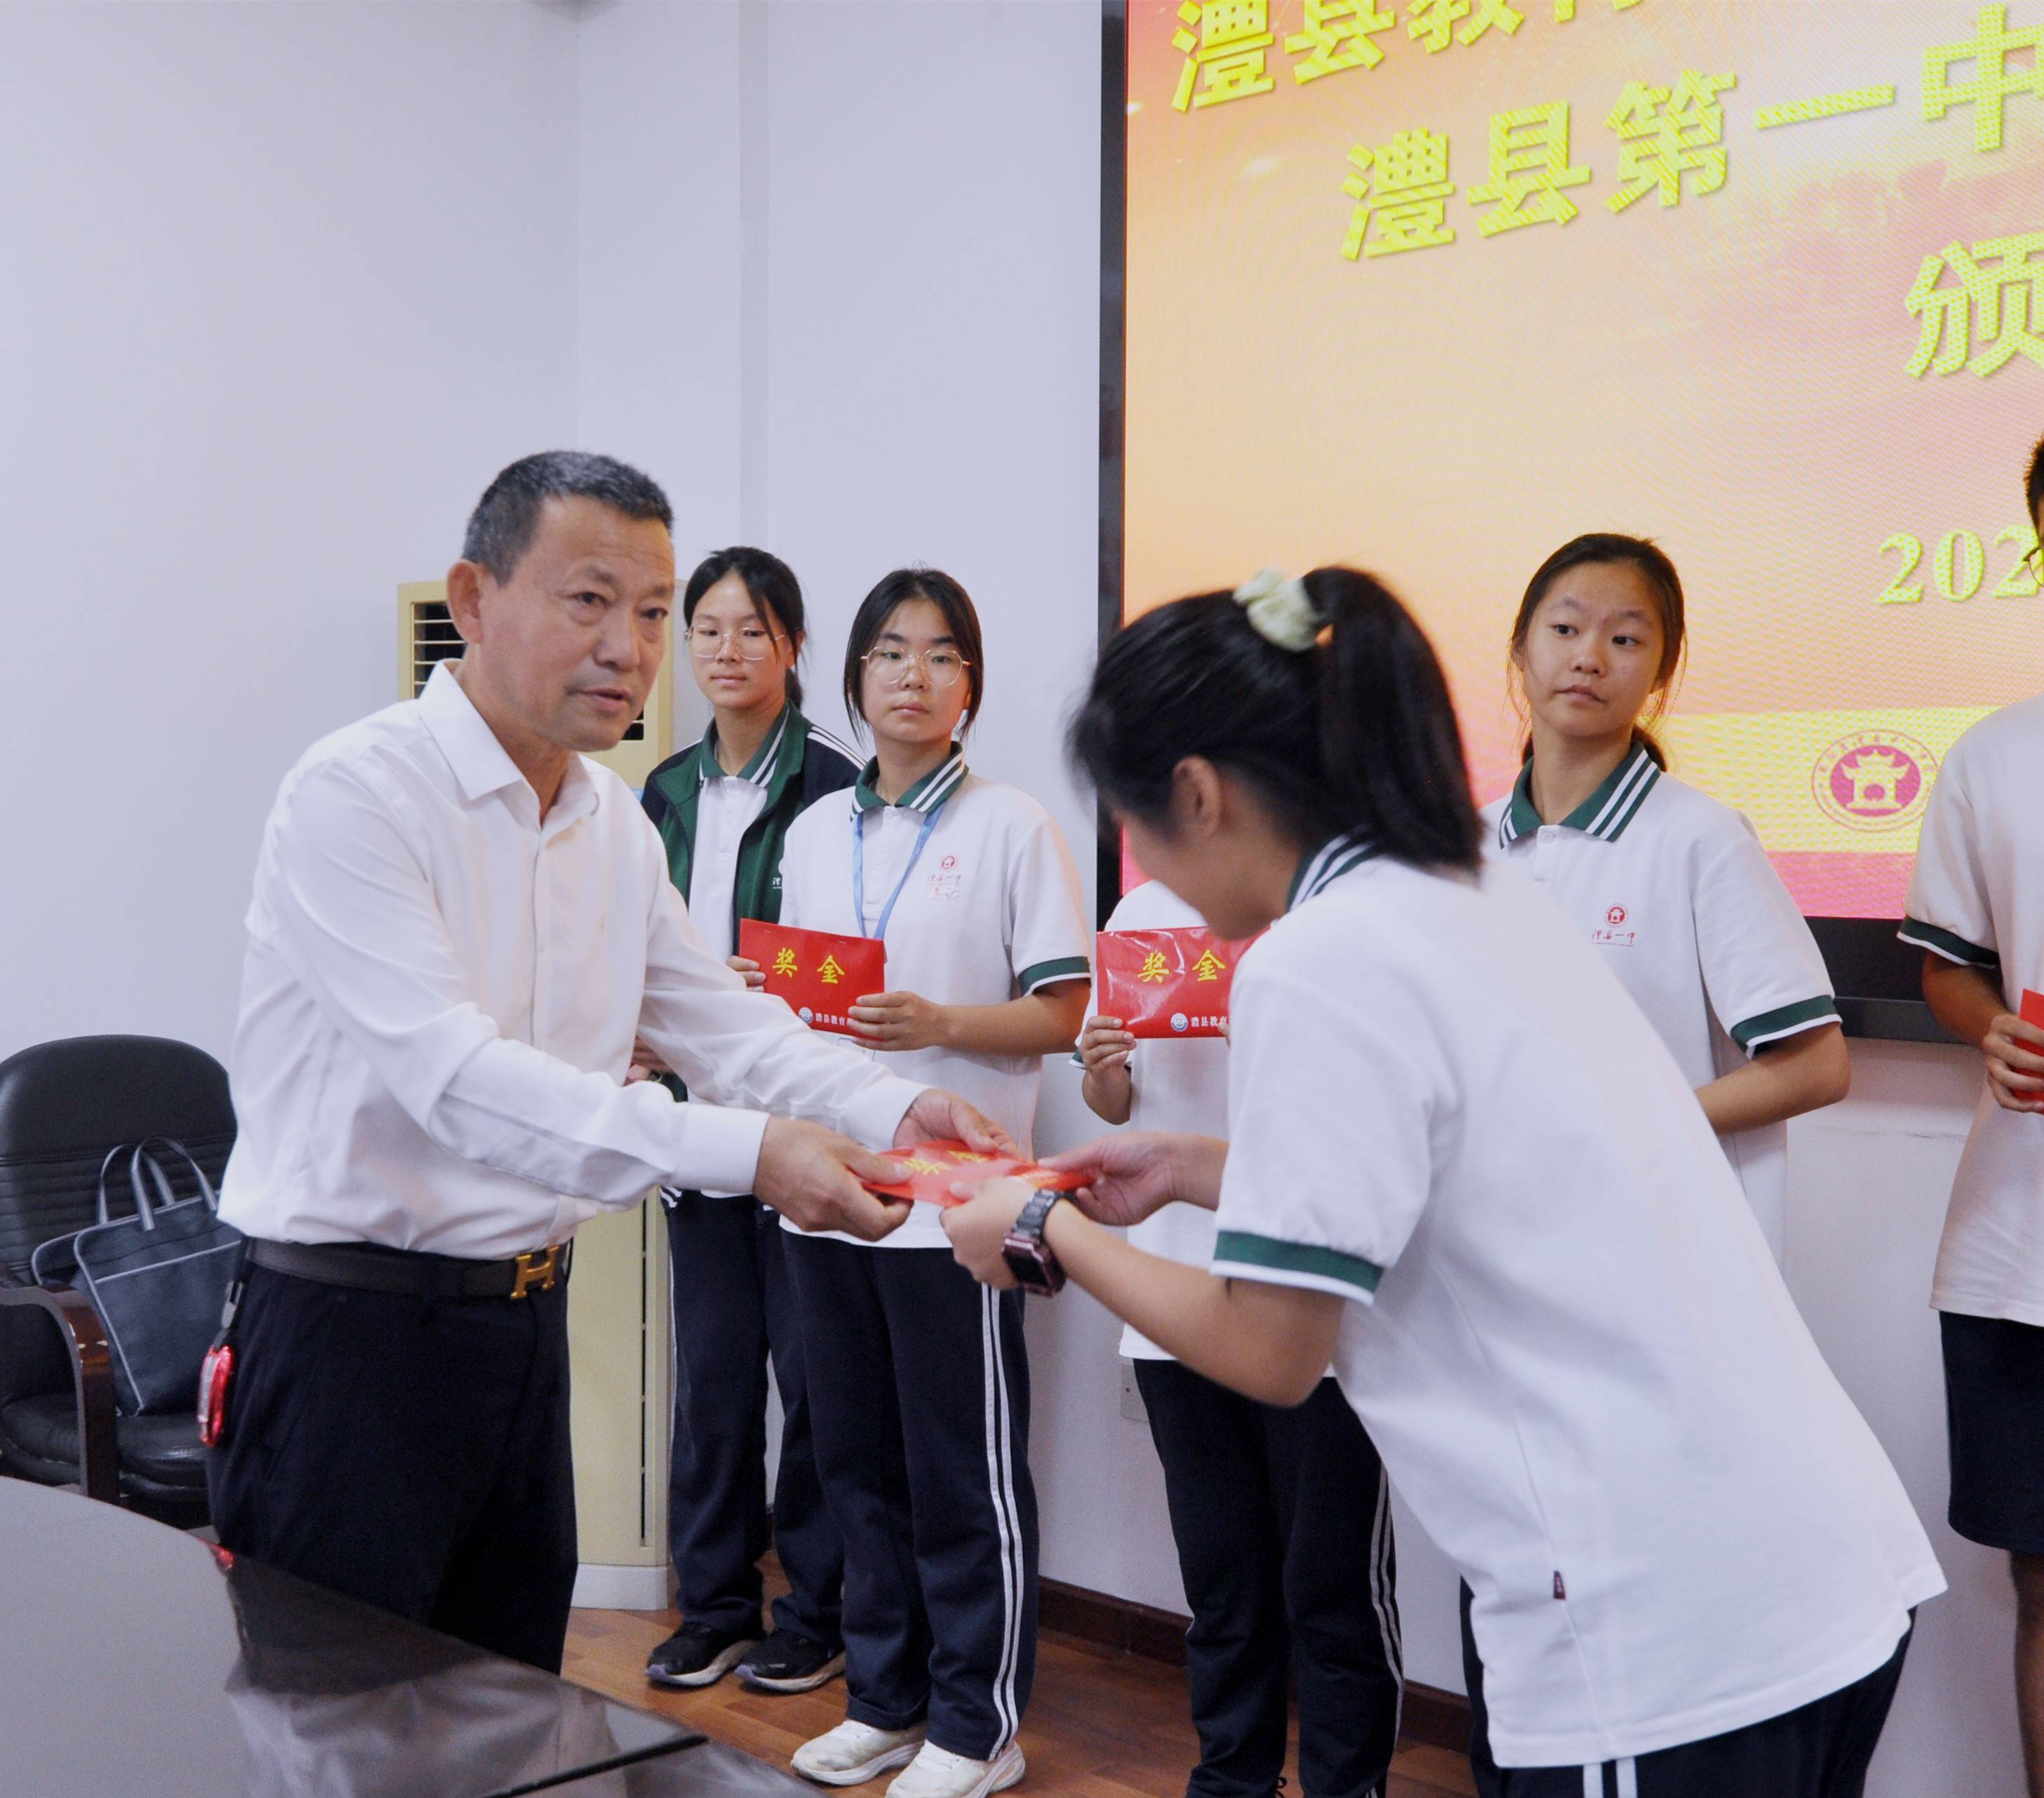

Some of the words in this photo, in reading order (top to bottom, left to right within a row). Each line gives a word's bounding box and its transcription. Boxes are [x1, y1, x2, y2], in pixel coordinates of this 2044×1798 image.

[1341, 4, 2044, 260] 澧县第一中
[1904, 232, 2044, 379] 颁
[1874, 524, 2044, 605] 202
[772, 947, 845, 984] 奖金
[1137, 950, 1227, 984] 奖金
